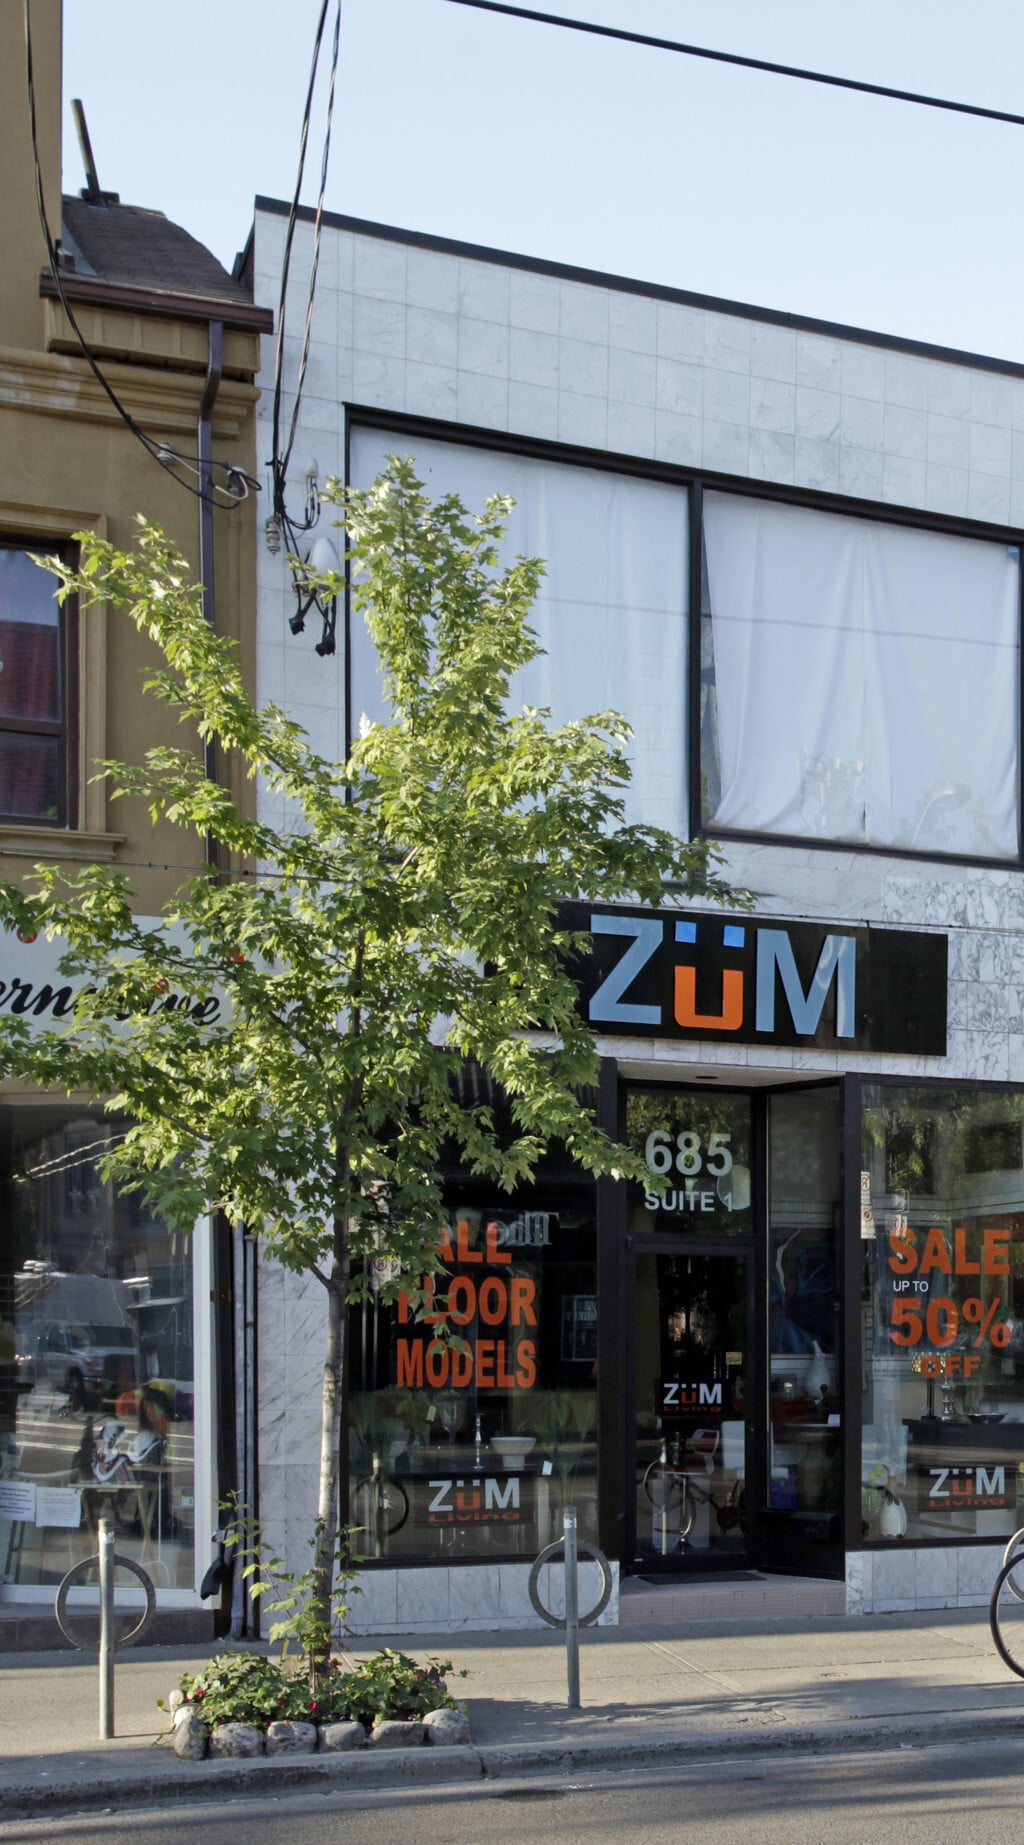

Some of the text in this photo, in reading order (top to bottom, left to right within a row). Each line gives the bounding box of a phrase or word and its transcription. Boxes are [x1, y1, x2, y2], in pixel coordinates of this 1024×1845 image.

[645, 1130, 733, 1176] 685
[644, 1190, 732, 1213] SUITE 1
[888, 1228, 1011, 1275] SALE
[893, 1280, 929, 1292] UP TO
[890, 1297, 1011, 1348] 50%
[396, 1338, 537, 1388] MODELS
[920, 1355, 981, 1378] OFF
